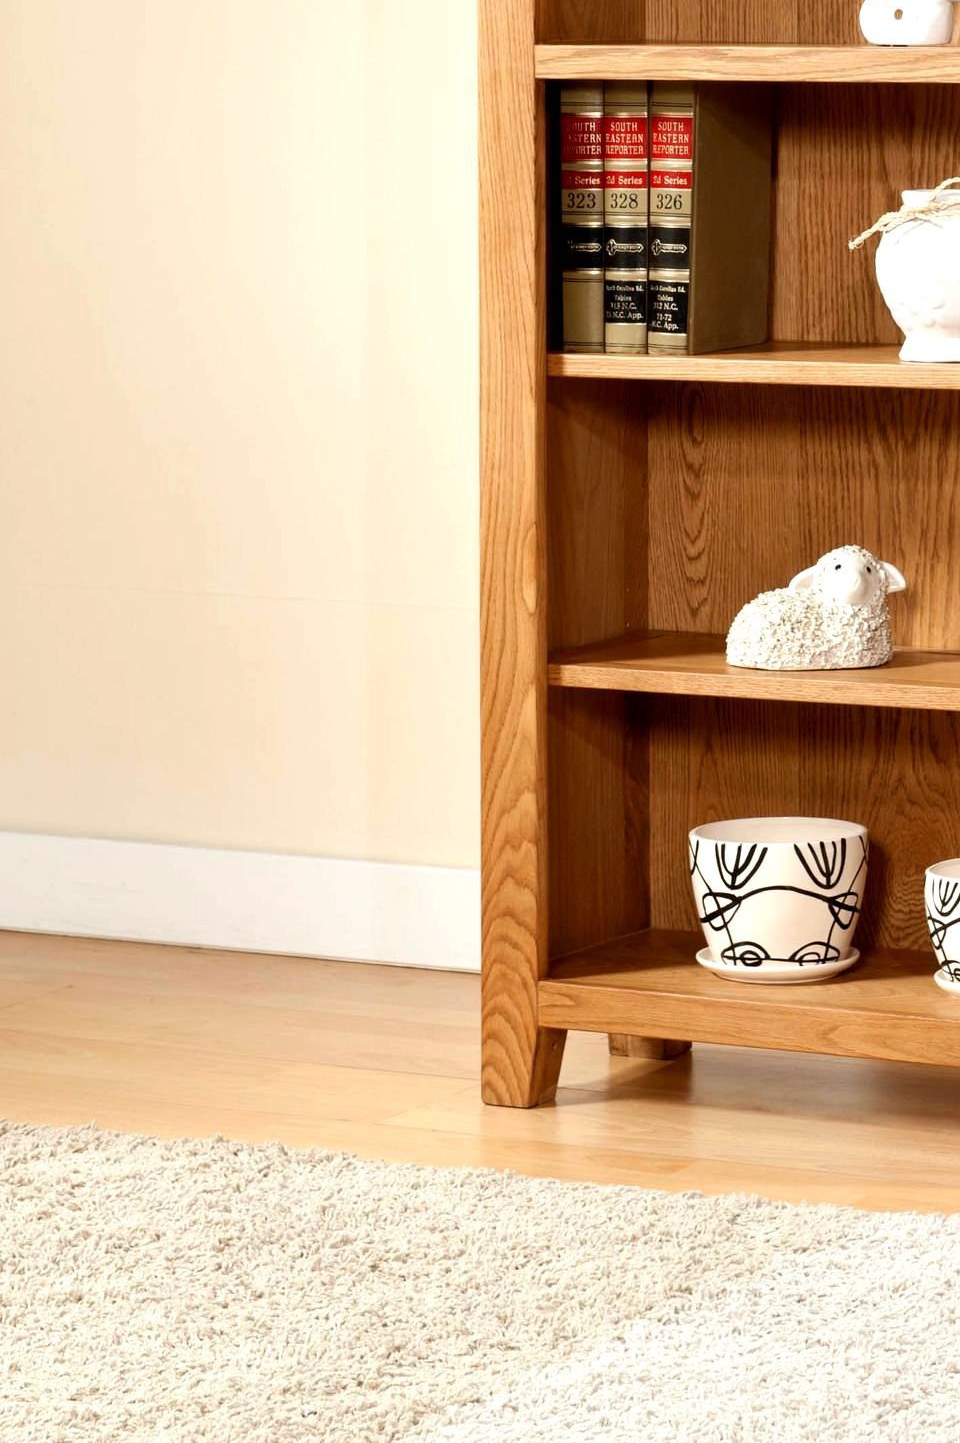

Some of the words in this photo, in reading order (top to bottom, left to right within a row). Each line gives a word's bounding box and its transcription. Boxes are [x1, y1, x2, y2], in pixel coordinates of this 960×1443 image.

[610, 121, 638, 131] SOUTH
[657, 121, 684, 131] SOUTH
[605, 133, 644, 143] EASTERN
[653, 133, 689, 144] EASTERN
[605, 145, 644, 155] REPORTER
[652, 145, 689, 155] REPORTER
[574, 175, 601, 185] Series
[606, 175, 616, 185] 2d
[618, 175, 643, 185] Series
[652, 175, 661, 184] 2d
[663, 175, 688, 185] Series
[567, 192, 596, 209] 323
[610, 193, 639, 209] 328
[656, 193, 683, 210] 326
[621, 302, 637, 310] N.C.
[663, 303, 679, 311] N.C.
[627, 312, 644, 320] App.
[663, 322, 680, 331] App.
